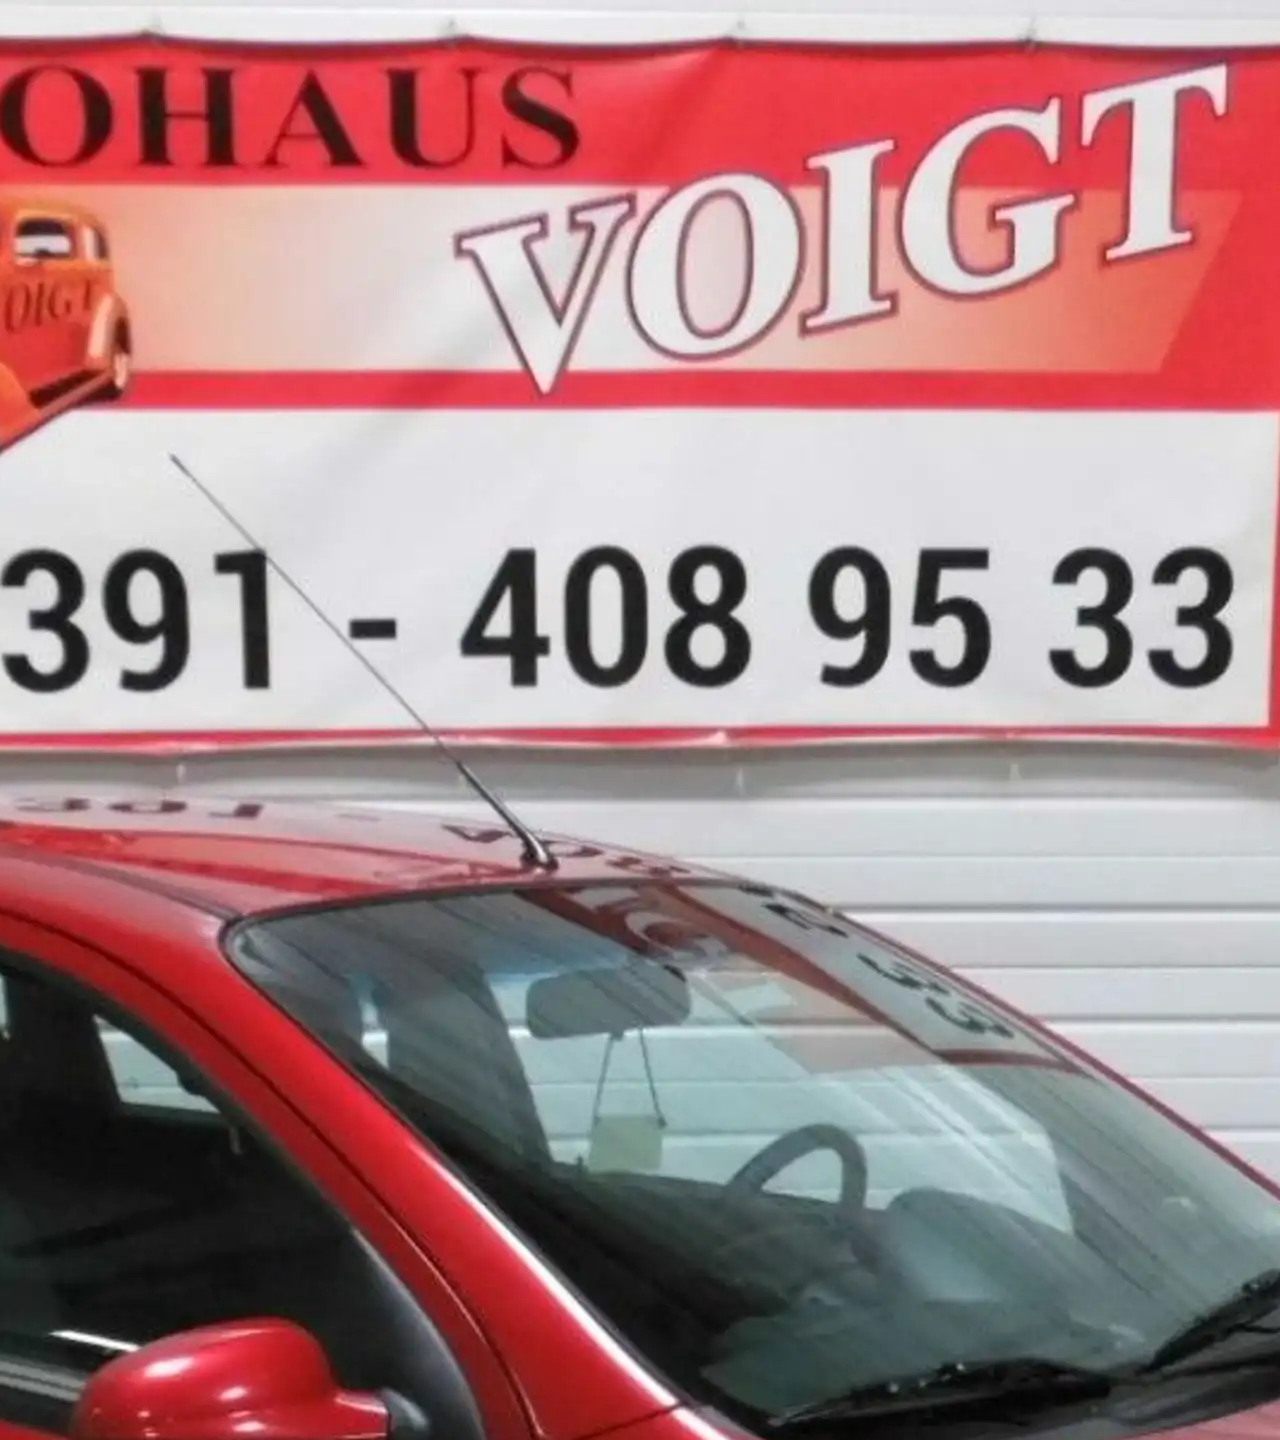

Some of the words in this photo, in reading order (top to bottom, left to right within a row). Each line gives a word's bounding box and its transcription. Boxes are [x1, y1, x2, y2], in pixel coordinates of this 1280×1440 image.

[453, 63, 1231, 395] VOIGT
[459, 546, 752, 688] 408
[808, 546, 992, 688] 95
[1048, 547, 1235, 688] 33
